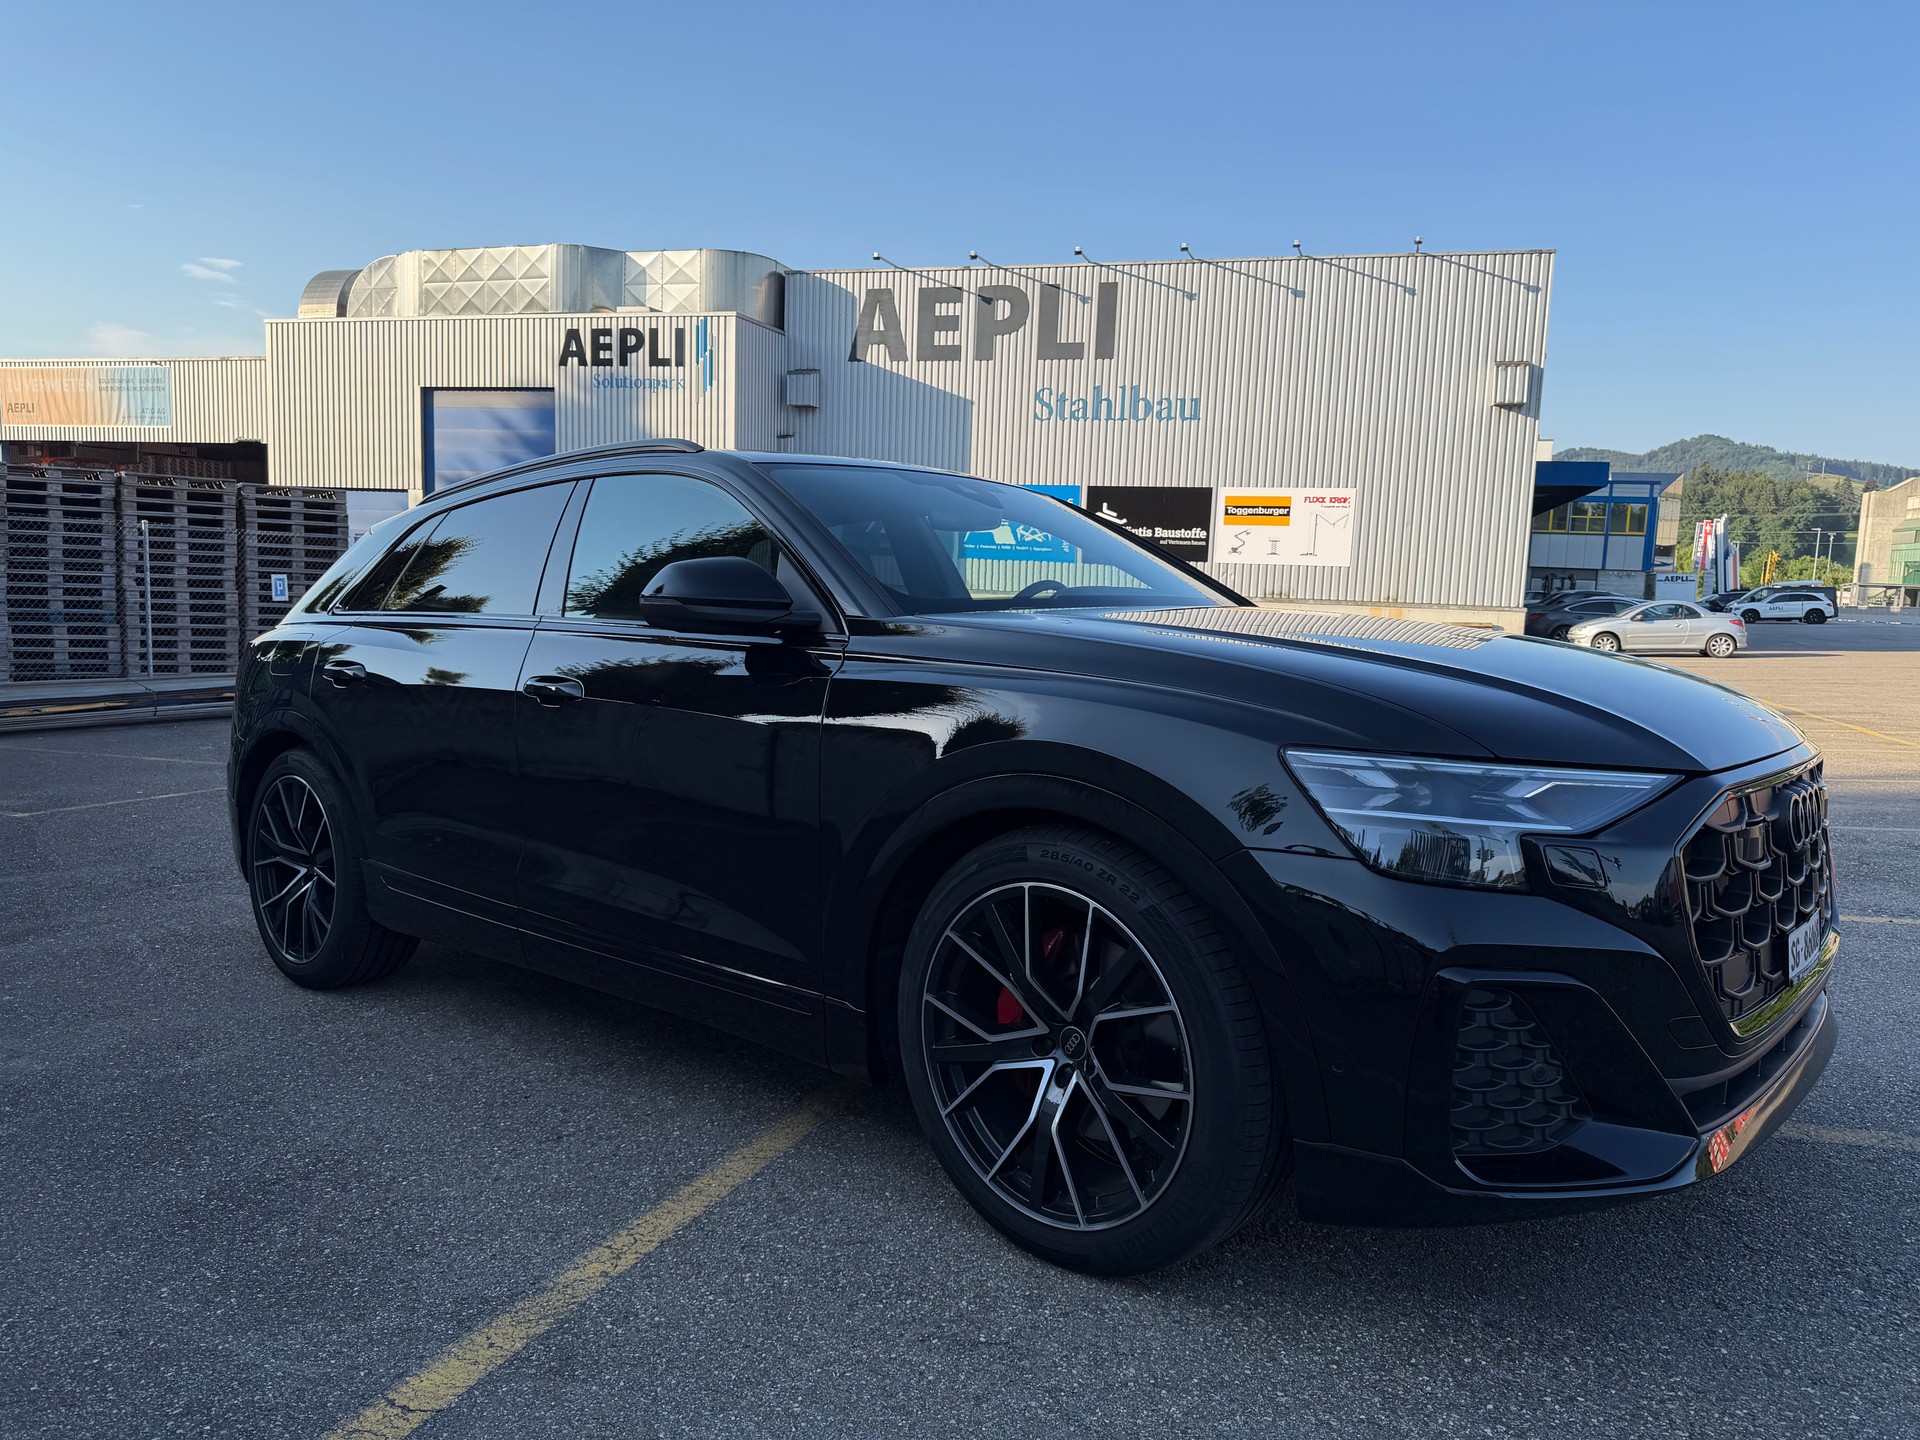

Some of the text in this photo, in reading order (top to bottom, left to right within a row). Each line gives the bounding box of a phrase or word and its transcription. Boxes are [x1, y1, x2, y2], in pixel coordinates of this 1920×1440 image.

[848, 282, 1119, 362] AEPLI
[559, 327, 685, 367] AEPLI
[593, 372, 686, 393] Solutionpark
[7, 402, 35, 413] AEPLI
[1034, 385, 1201, 422] Stahlbau
[1226, 506, 1289, 516] Toggenburger
[1122, 525, 1207, 539] ntis Baustoffe
[276, 580, 284, 595] P
[1040, 849, 1140, 905] 285/40 ZR 22
